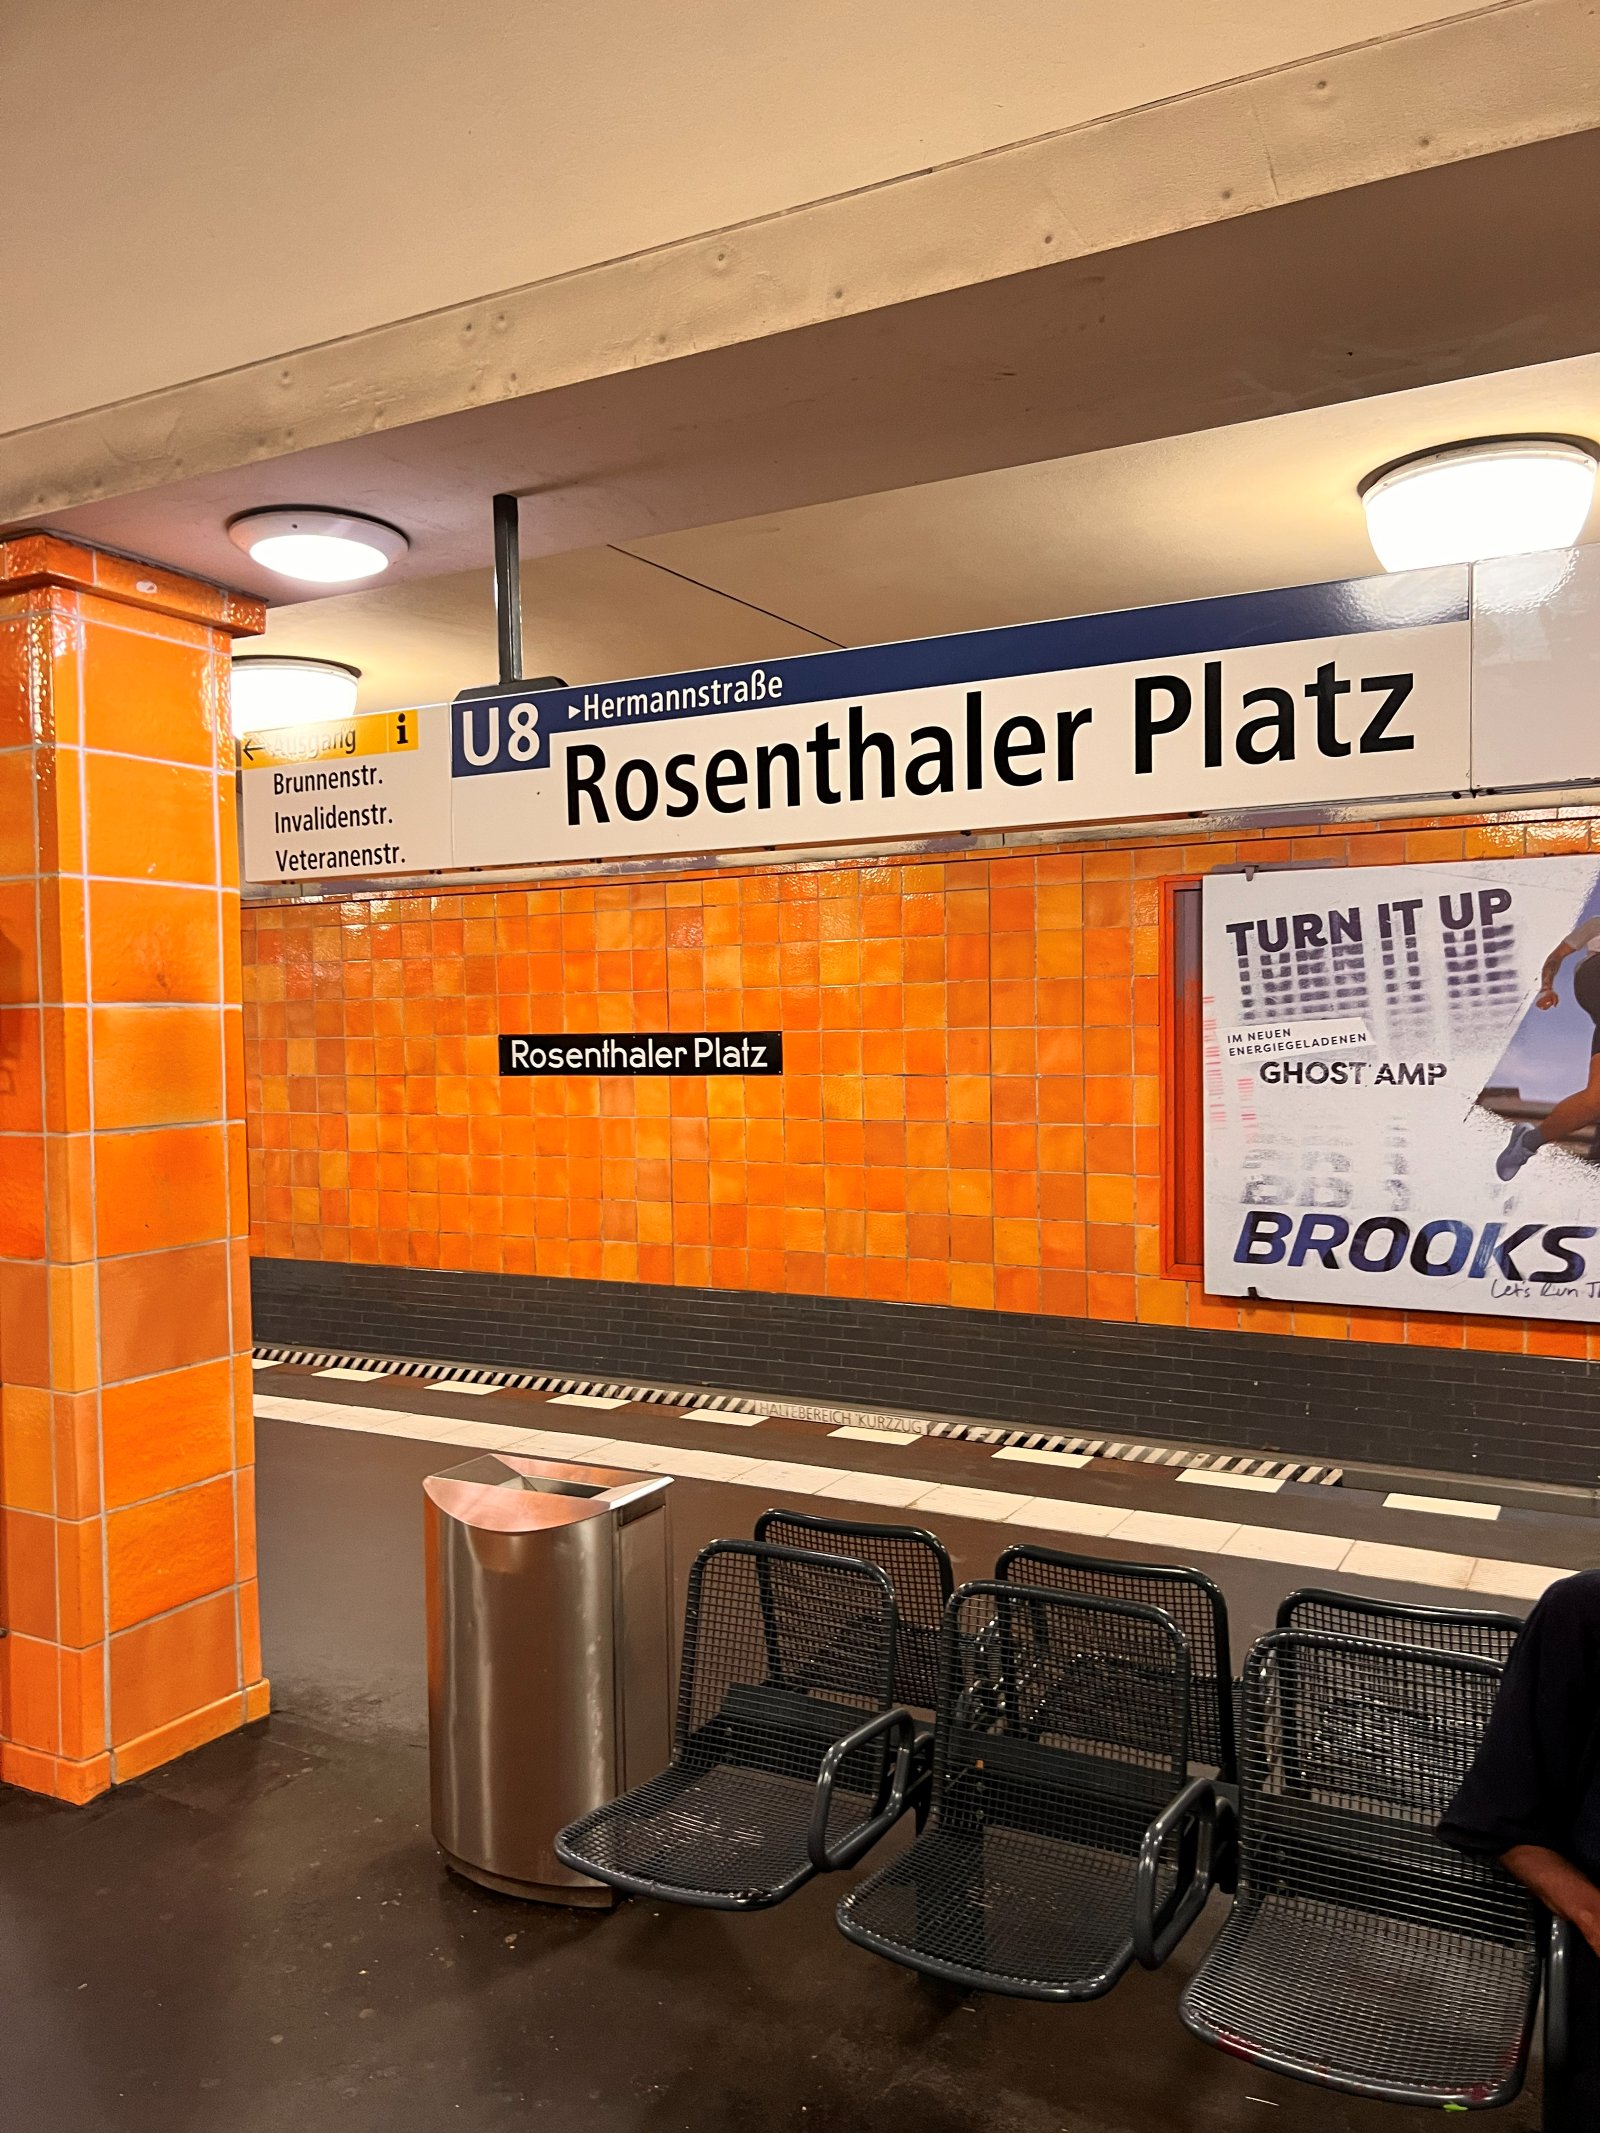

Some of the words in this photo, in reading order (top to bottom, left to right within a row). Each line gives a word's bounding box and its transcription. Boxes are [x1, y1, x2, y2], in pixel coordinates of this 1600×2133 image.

[584, 669, 783, 721] Hermannstraße
[462, 702, 540, 766] U8
[566, 691, 1092, 826] Rosenthaler
[1135, 660, 1415, 775] Platz
[274, 765, 383, 795] Brunnenstr.
[275, 804, 393, 833] Invalidenstr.
[276, 843, 406, 872] Veteranenstr.
[1226, 907, 1363, 956] TURN
[1378, 898, 1423, 938] IT
[1439, 888, 1512, 930] UP
[1227, 1034, 1242, 1044] IM
[1248, 1028, 1291, 1041] NEUEN
[1229, 1033, 1367, 1057] ENERGIEGELADENEN
[511, 1038, 687, 1068] Rosenthaler
[695, 1037, 768, 1068] Platz
[1259, 1061, 1366, 1085] GHOST
[1374, 1062, 1447, 1086] AMP
[1233, 1210, 1598, 1283] BROOKS
[760, 1402, 850, 1425] HALTEBEREICH
